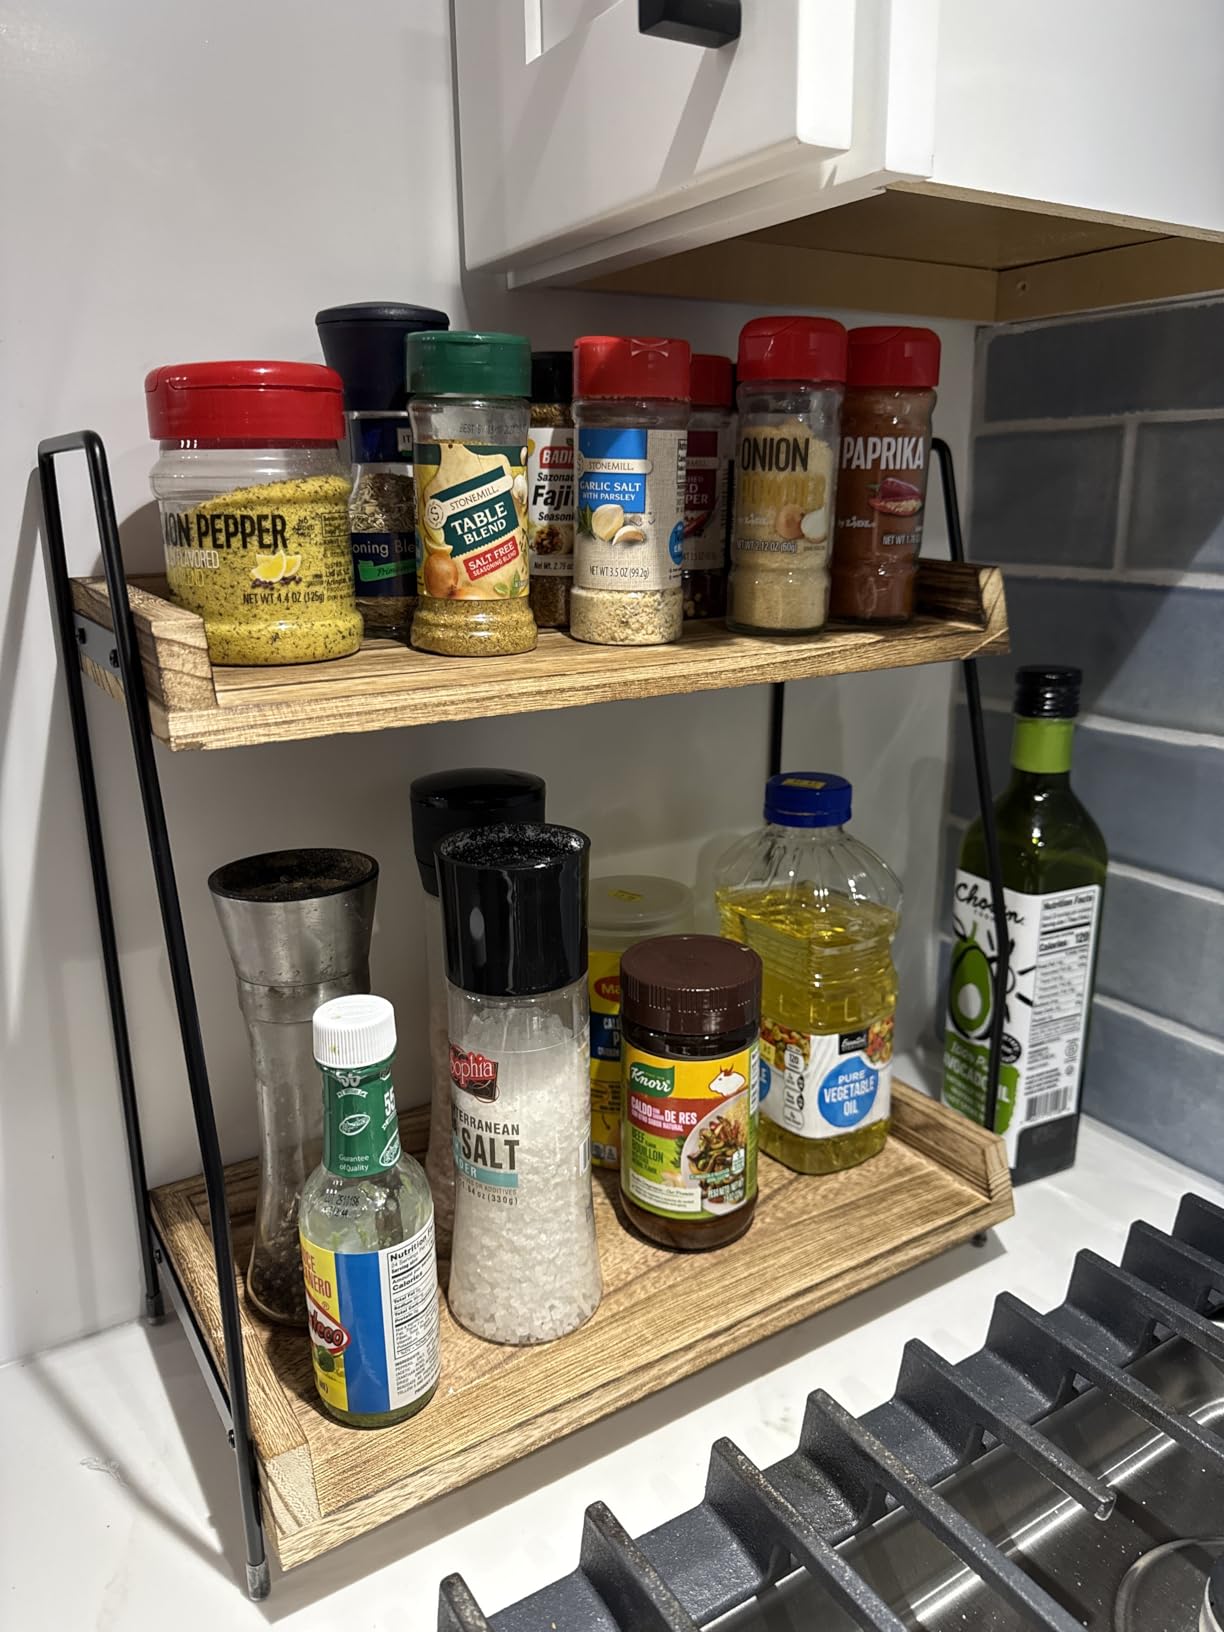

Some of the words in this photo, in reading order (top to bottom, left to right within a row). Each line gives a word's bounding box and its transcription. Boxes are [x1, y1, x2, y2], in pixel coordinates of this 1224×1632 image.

[741, 437, 810, 472] ONION
[841, 436, 924, 471] PAPRIKA
[531, 484, 574, 510] Faji
[579, 481, 611, 492] GARLIC
[613, 481, 642, 492] SALT
[600, 493, 636, 501] PARSLEY
[196, 513, 288, 549] PEPPER
[451, 502, 508, 536] TABLE
[463, 518, 507, 545] BLEND
[468, 552, 493, 571] SALT
[493, 540, 515, 560] FREE
[589, 565, 599, 576] NET
[600, 566, 609, 577] WT
[609, 566, 619, 577] 3.5
[619, 567, 628, 578] OZ
[243, 592, 258, 604] NET
[260, 592, 274, 604] WT
[277, 592, 290, 603] 4.4
[291, 591, 302, 603] OZ
[631, 1066, 671, 1092] Knorr
[823, 1075, 875, 1104] VEGETABLE
[837, 1068, 866, 1085] PURE
[631, 1096, 653, 1117] CALDO
[664, 1109, 676, 1123] DE
[678, 1111, 698, 1125] RES
[843, 1099, 859, 1117] OIL
[461, 1127, 520, 1171] SALT
[390, 1235, 427, 1261] Nutrition
[392, 1271, 423, 1291] Calories
